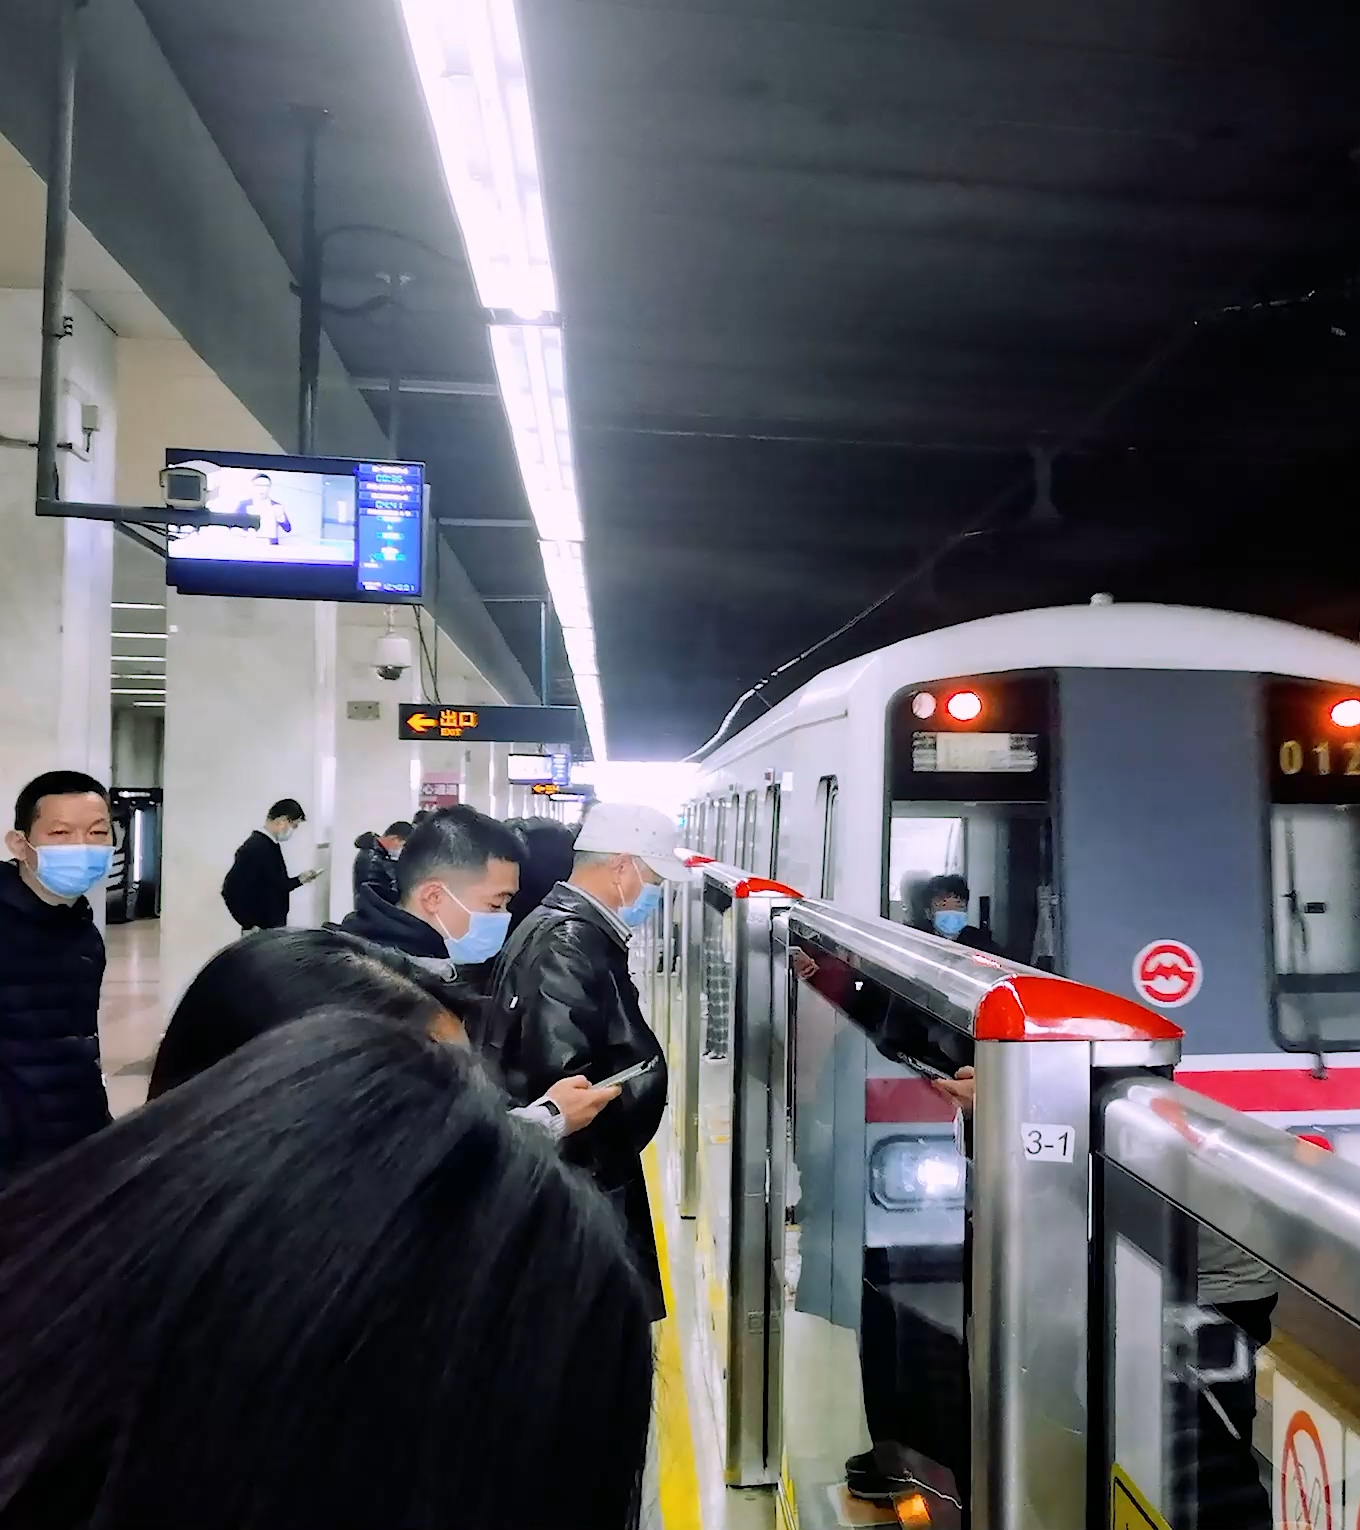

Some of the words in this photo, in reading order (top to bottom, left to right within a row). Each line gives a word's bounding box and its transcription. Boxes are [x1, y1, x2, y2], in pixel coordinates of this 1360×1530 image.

[440, 709, 477, 728] 出口
[440, 728, 463, 736] EXIT
[1026, 1130, 1068, 1156] 3-1
